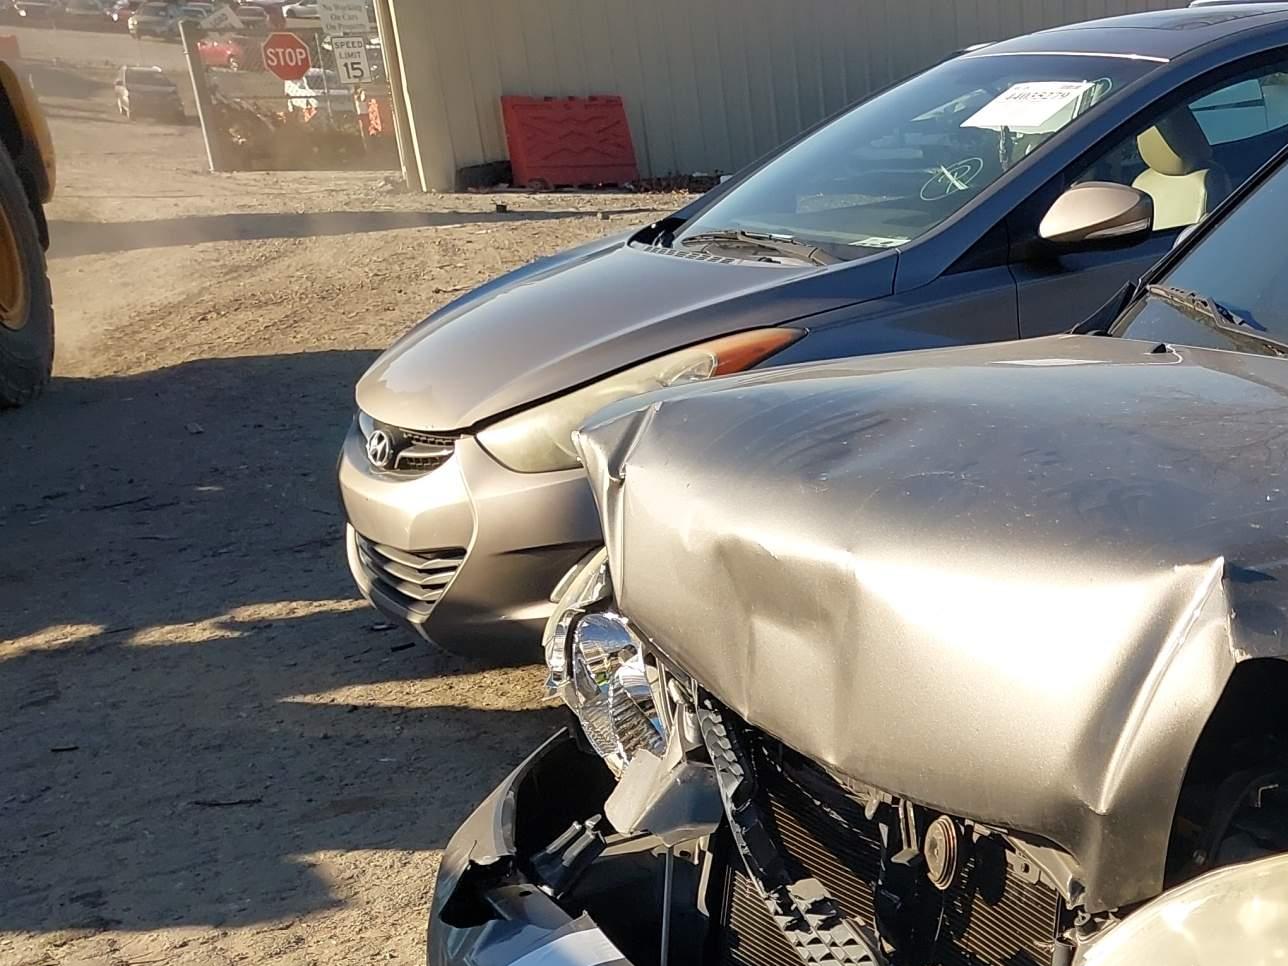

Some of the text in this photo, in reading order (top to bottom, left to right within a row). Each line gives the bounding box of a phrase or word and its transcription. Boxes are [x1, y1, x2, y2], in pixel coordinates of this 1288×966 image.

[334, 41, 363, 49] SPEED
[266, 48, 306, 66] STOP
[338, 51, 362, 59] LIMIT
[343, 62, 364, 79] 15
